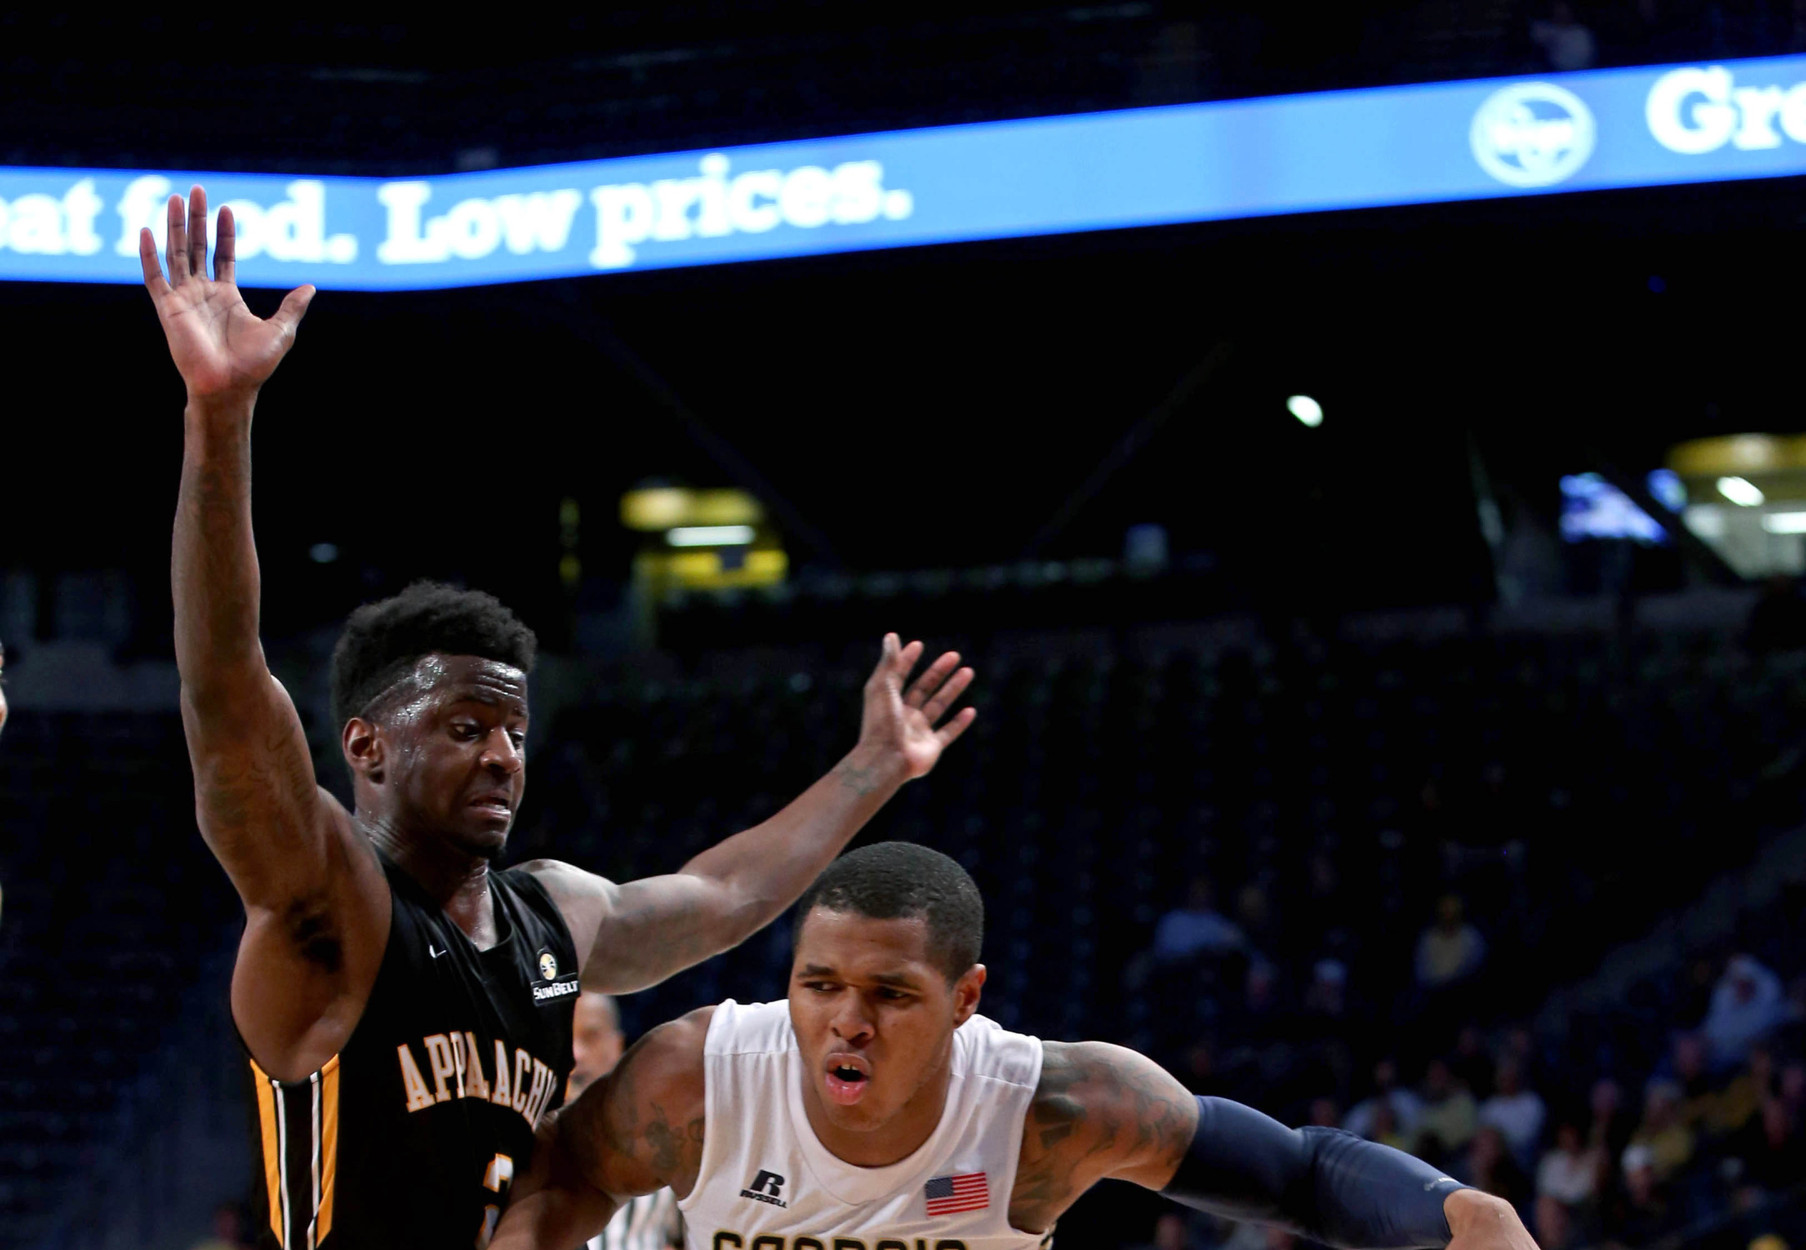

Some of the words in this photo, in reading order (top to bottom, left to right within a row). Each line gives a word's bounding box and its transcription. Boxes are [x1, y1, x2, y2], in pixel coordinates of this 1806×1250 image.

[0, 177, 103, 256] at
[377, 181, 582, 265] Low
[590, 153, 914, 269] prices.
[397, 1030, 557, 1133] APPAACHI
